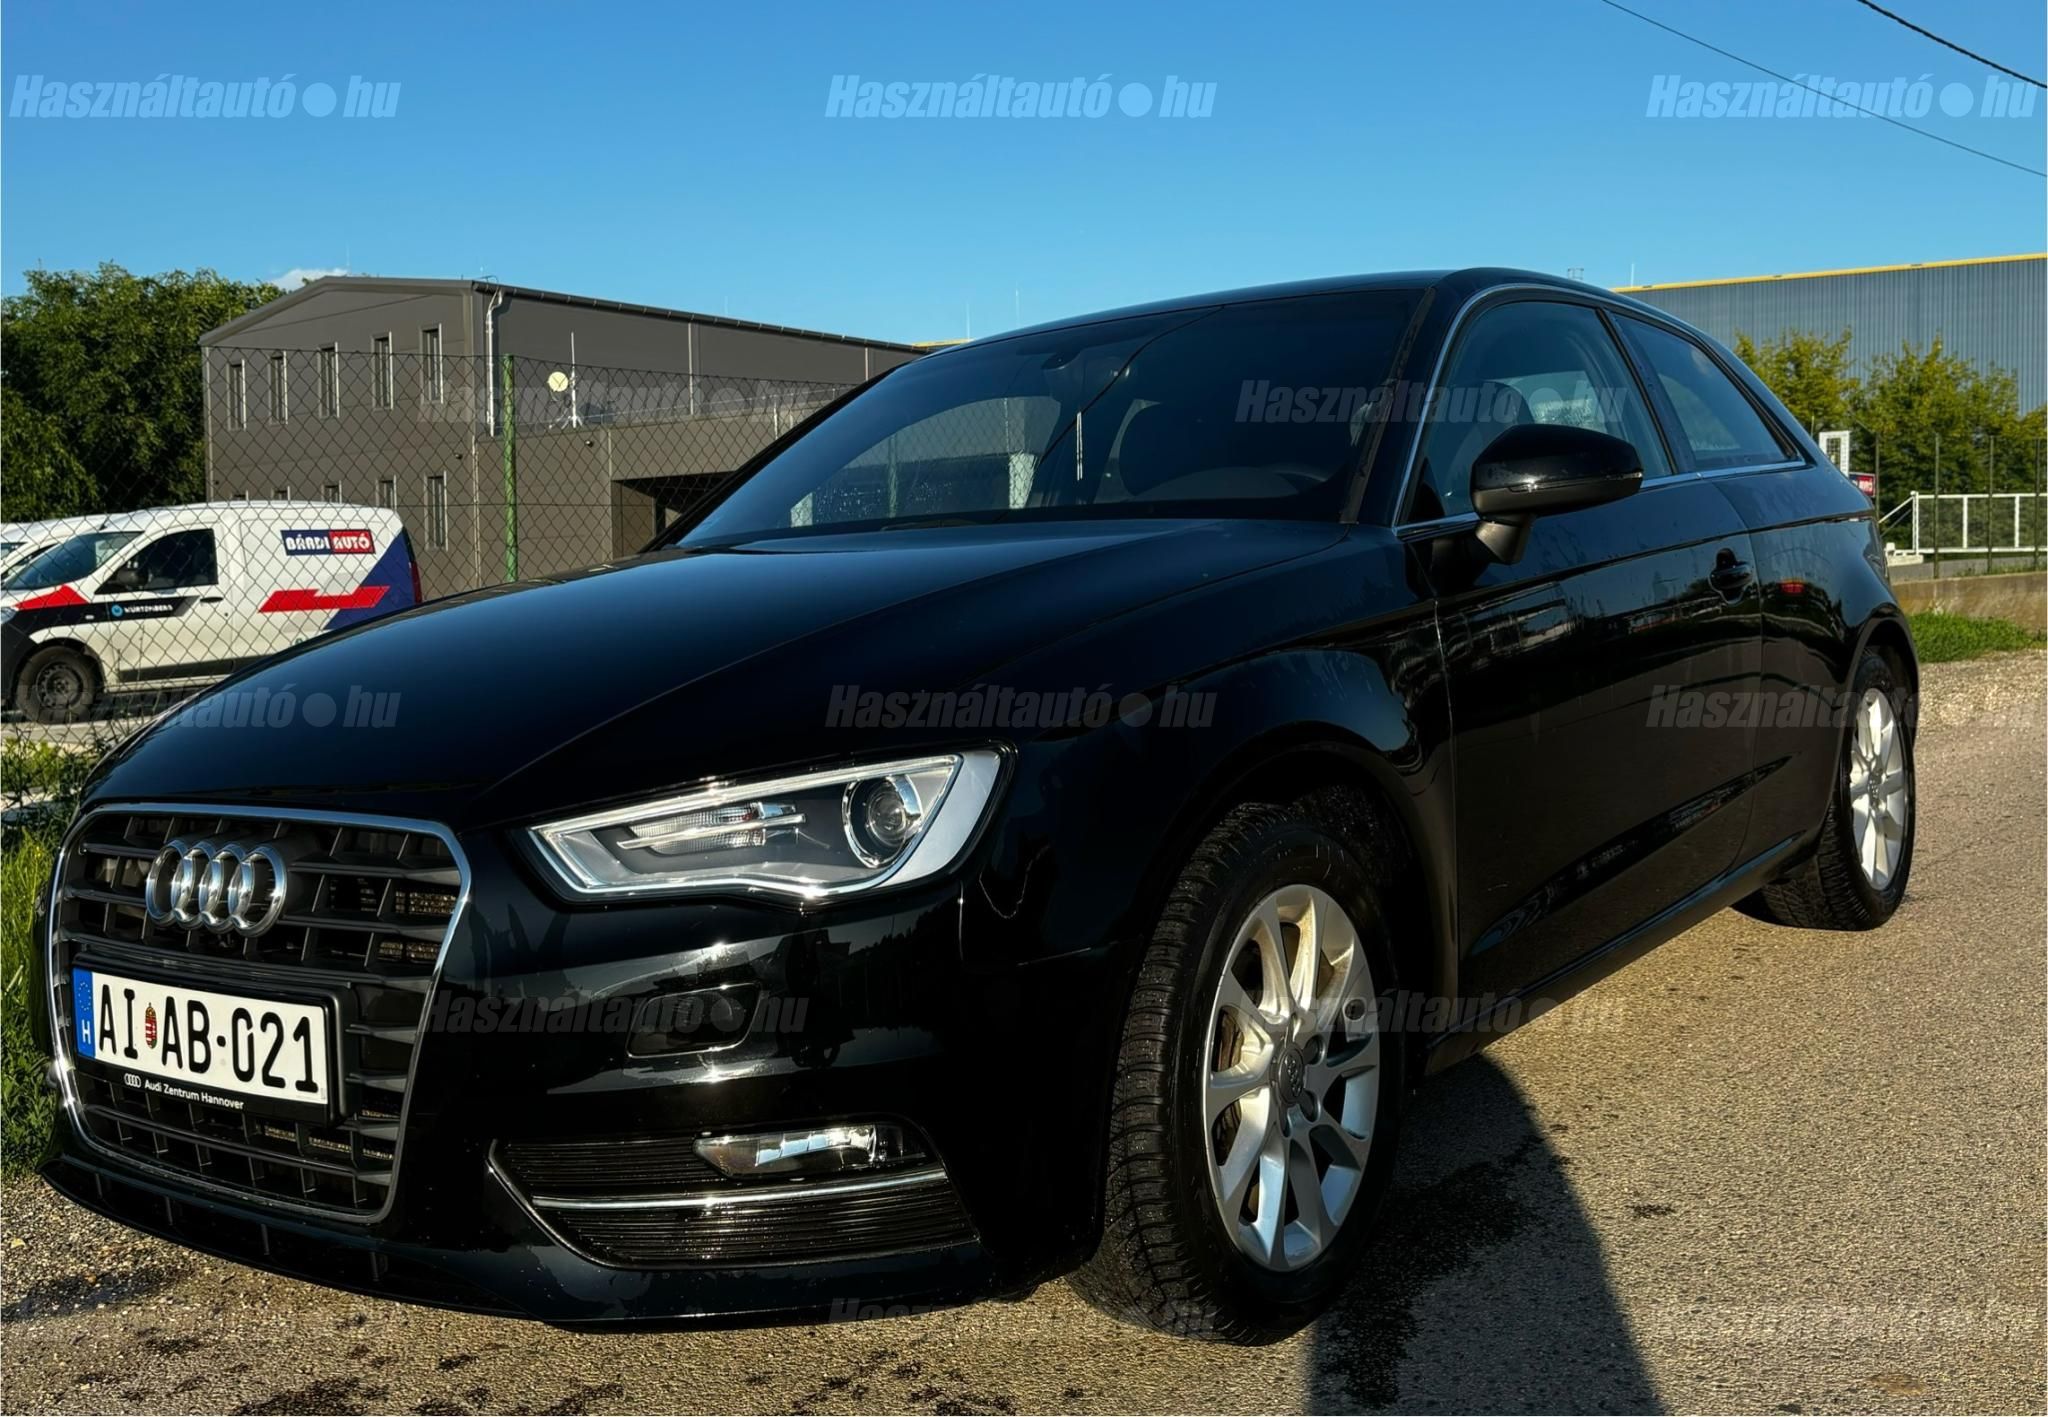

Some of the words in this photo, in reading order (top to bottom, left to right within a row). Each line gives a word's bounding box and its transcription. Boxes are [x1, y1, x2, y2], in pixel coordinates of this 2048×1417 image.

[285, 533, 330, 550] BÁRDI
[333, 532, 371, 550] AUTÓ
[81, 1020, 91, 1045] H
[144, 1079, 162, 1092] Audi
[163, 1084, 200, 1101] Zentrum
[201, 1092, 244, 1110] Hannover
